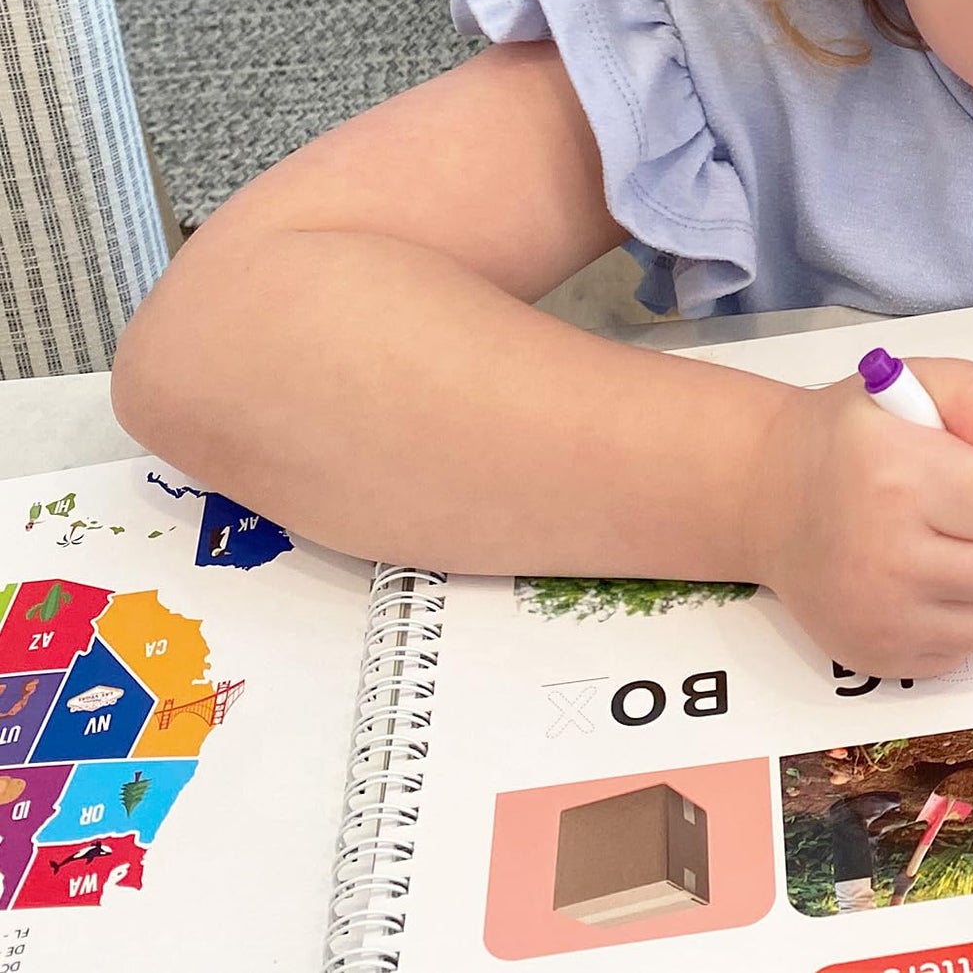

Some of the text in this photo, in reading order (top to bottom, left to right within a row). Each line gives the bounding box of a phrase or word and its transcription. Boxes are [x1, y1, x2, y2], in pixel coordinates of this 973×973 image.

[237, 514, 258, 533] AK
[27, 630, 55, 651] AZ
[145, 638, 167, 658] CA
[84, 713, 112, 736] NV
[12, 800, 31, 820] ID
[79, 803, 105, 826] OR
[69, 873, 98, 898] WA
[14, 927, 30, 939] FL
[5, 944, 26, 958] DE
